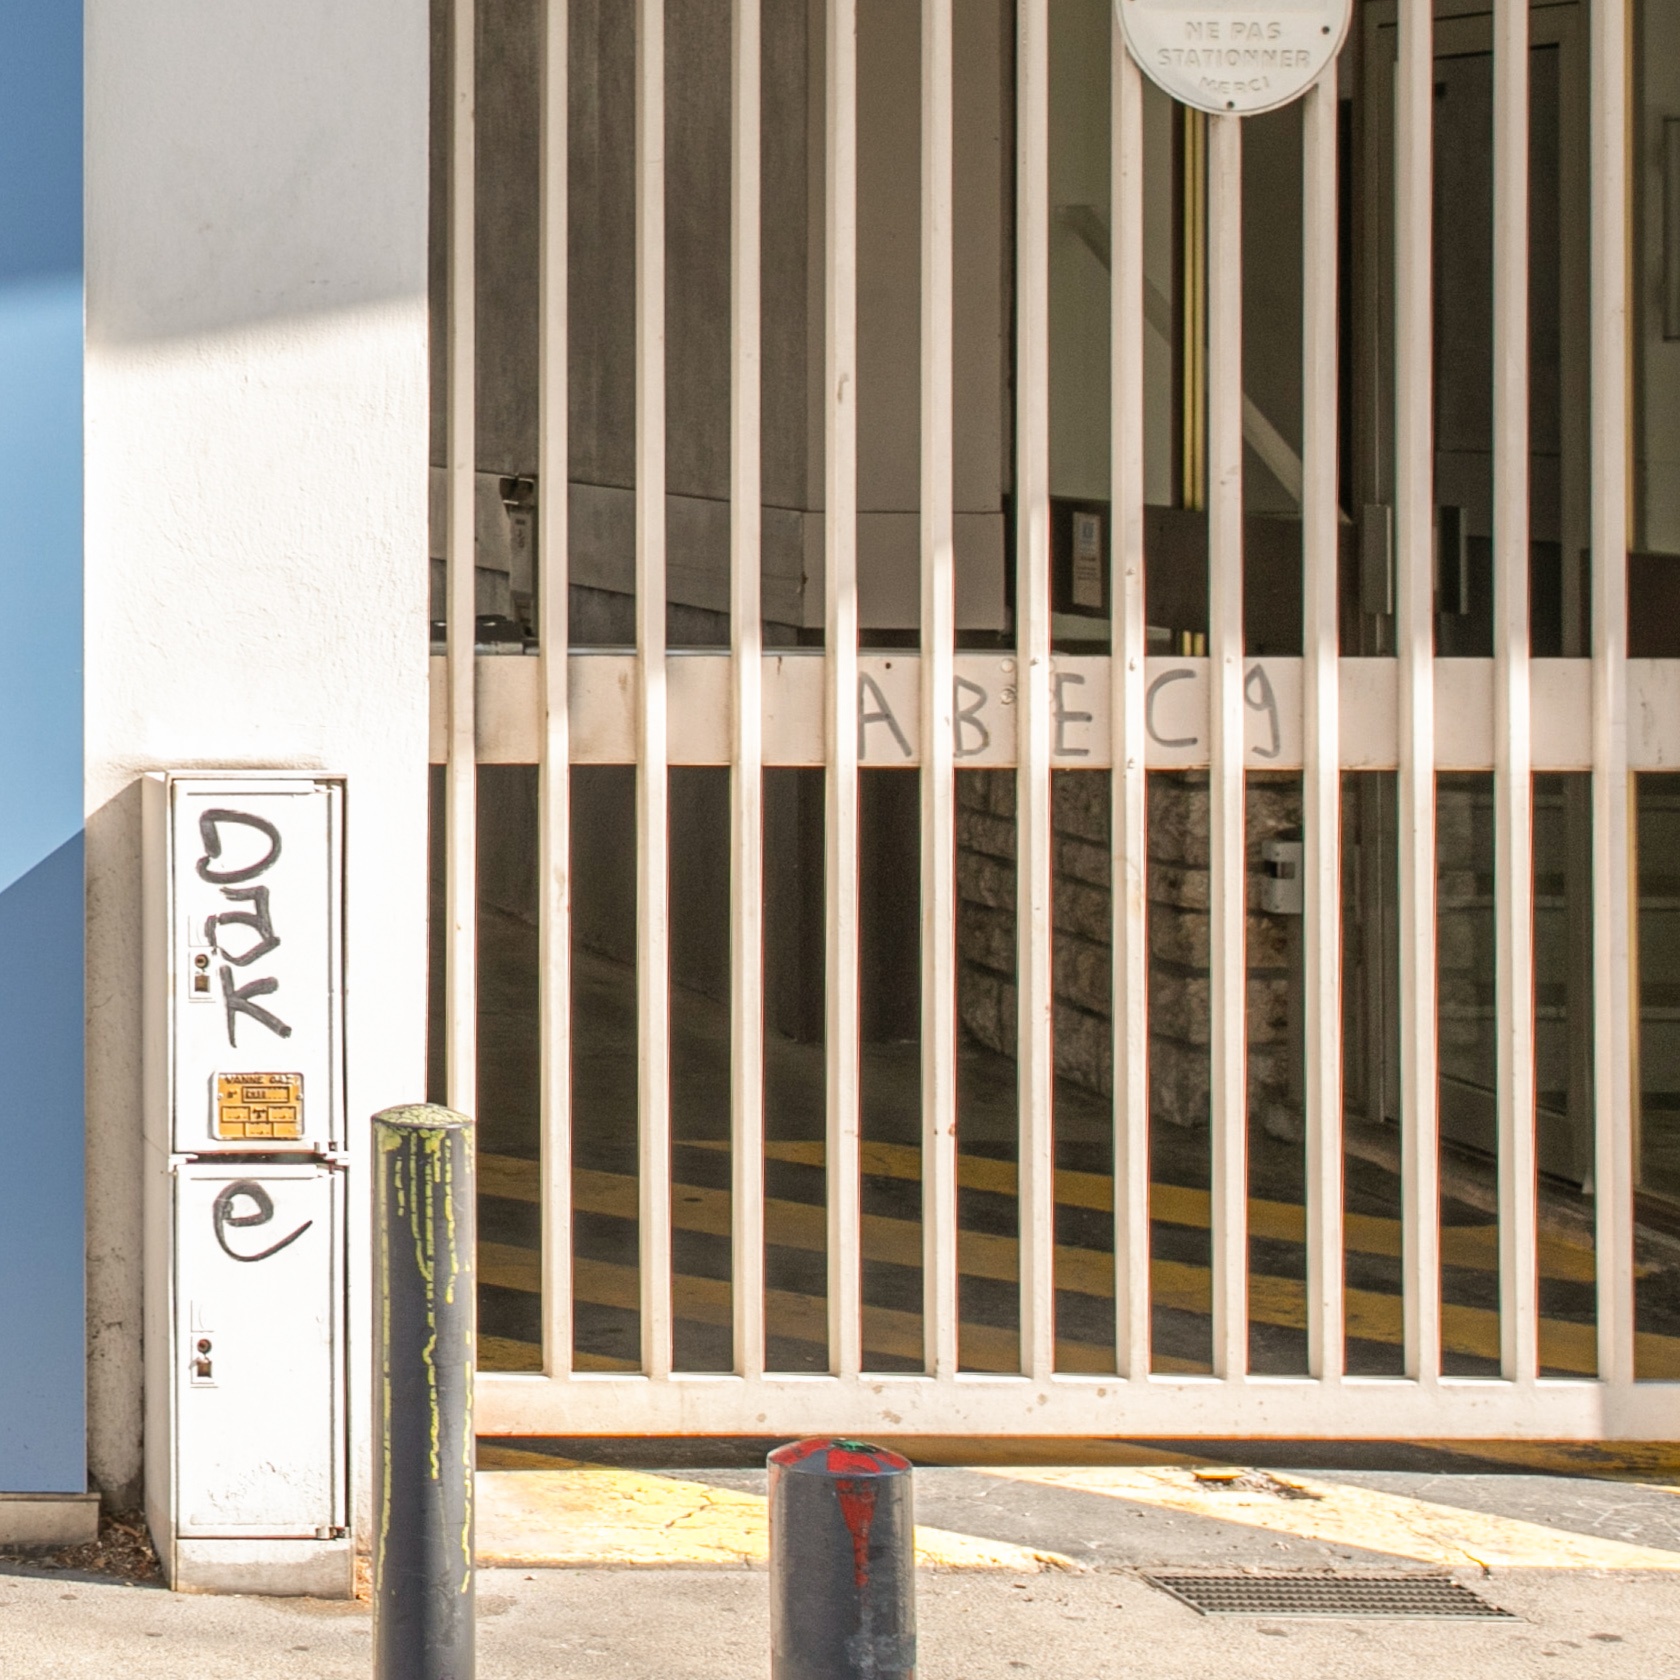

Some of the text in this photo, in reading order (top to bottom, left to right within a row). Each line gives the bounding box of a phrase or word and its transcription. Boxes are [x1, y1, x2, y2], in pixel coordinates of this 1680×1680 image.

[1186, 21, 1281, 40] NE PAS
[1158, 48, 1310, 69] STATIONNER
[1200, 76, 1270, 96] MERCI
